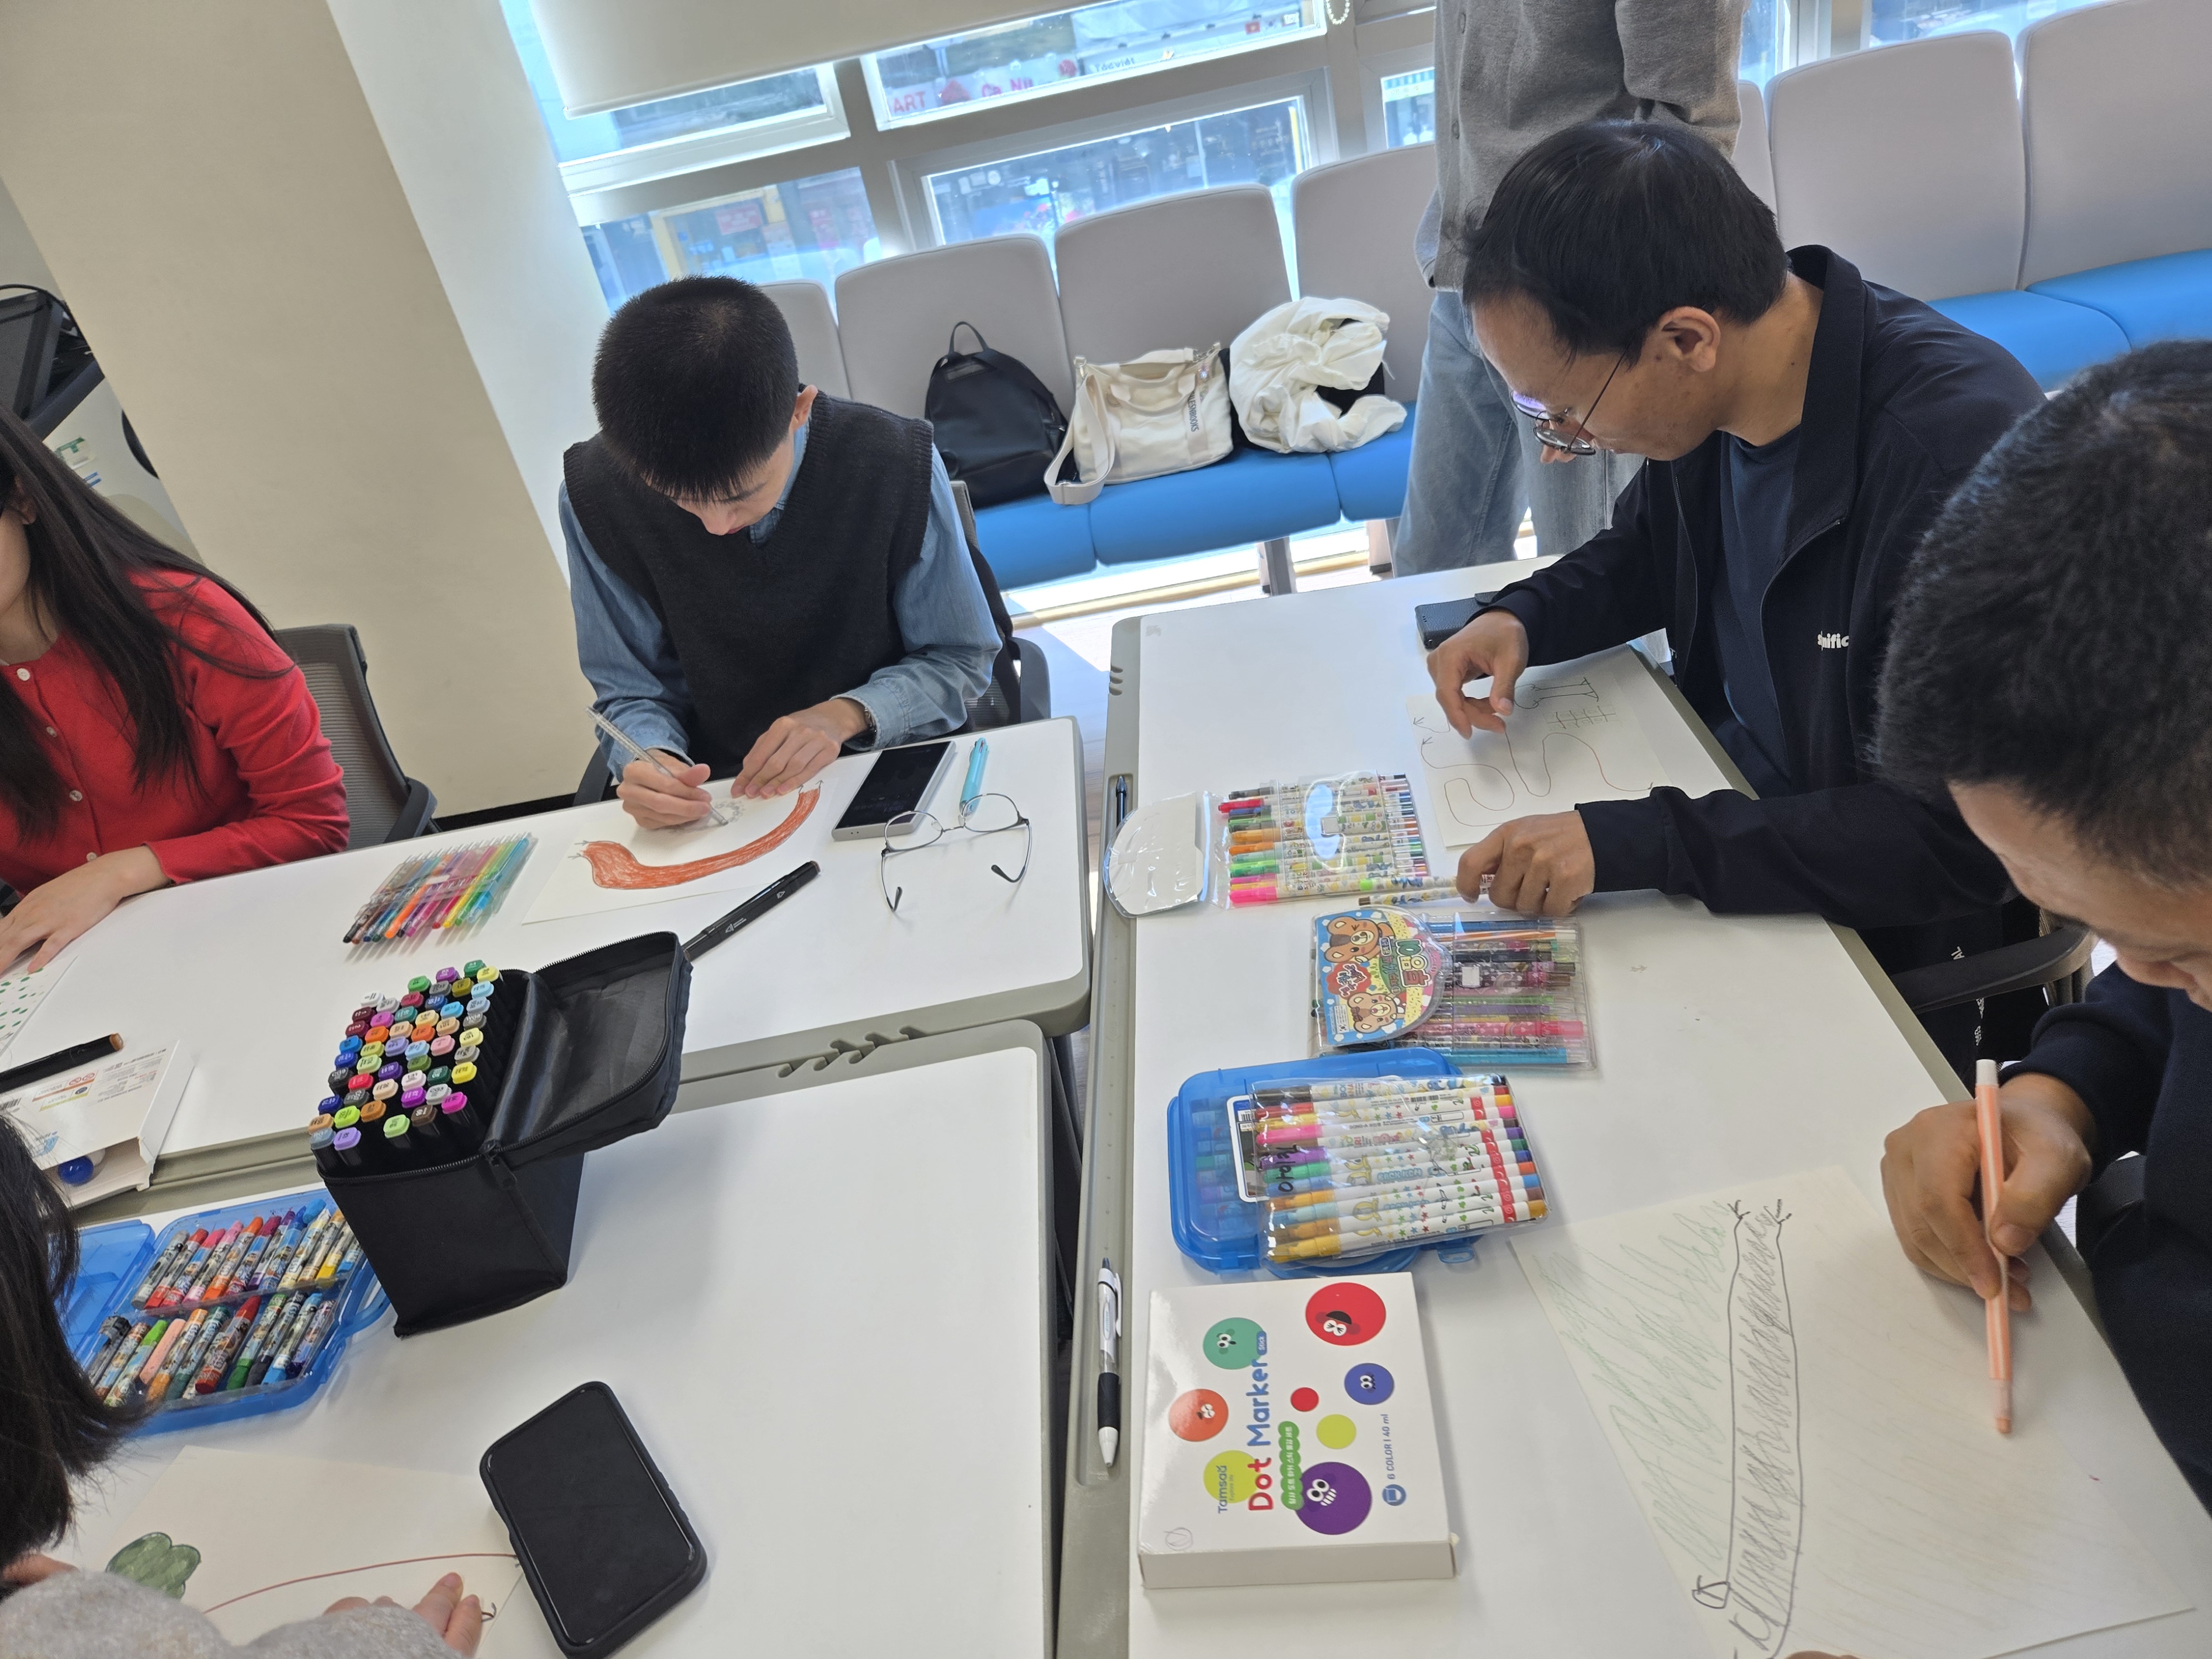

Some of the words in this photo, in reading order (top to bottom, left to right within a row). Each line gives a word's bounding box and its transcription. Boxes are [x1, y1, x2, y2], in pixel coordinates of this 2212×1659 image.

[893, 90, 926, 114] ART
[1246, 1359, 1271, 1447] Marker
[1380, 1413, 1389, 1424] ml
[1381, 1426, 1390, 1437] 40
[1384, 1444, 1395, 1471] COLOR
[1248, 1457, 1274, 1511] Dot
